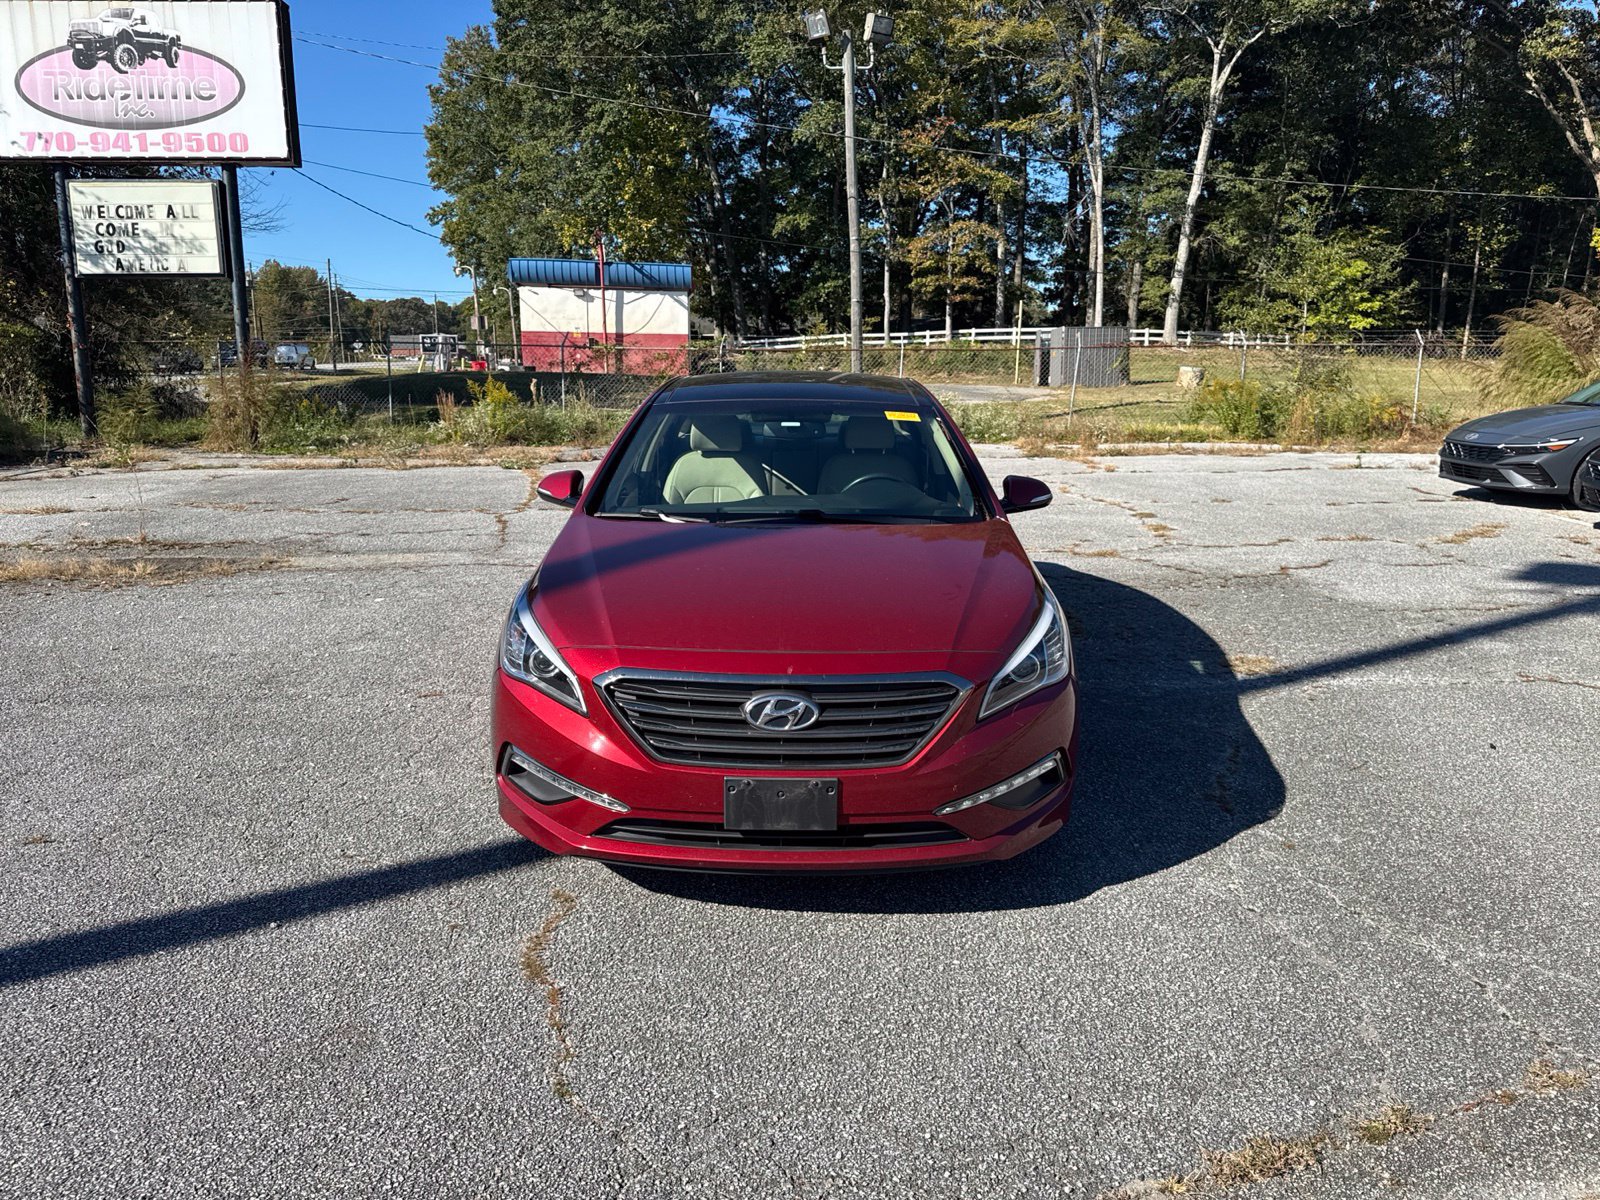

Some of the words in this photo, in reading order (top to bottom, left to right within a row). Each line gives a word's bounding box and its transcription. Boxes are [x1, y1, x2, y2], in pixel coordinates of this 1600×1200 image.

[113, 93, 155, 118] Inc.
[20, 131, 249, 153] 770-941-9500
[81, 204, 154, 219] WELCOME
[166, 204, 198, 219] ALL
[95, 222, 140, 237] COME
